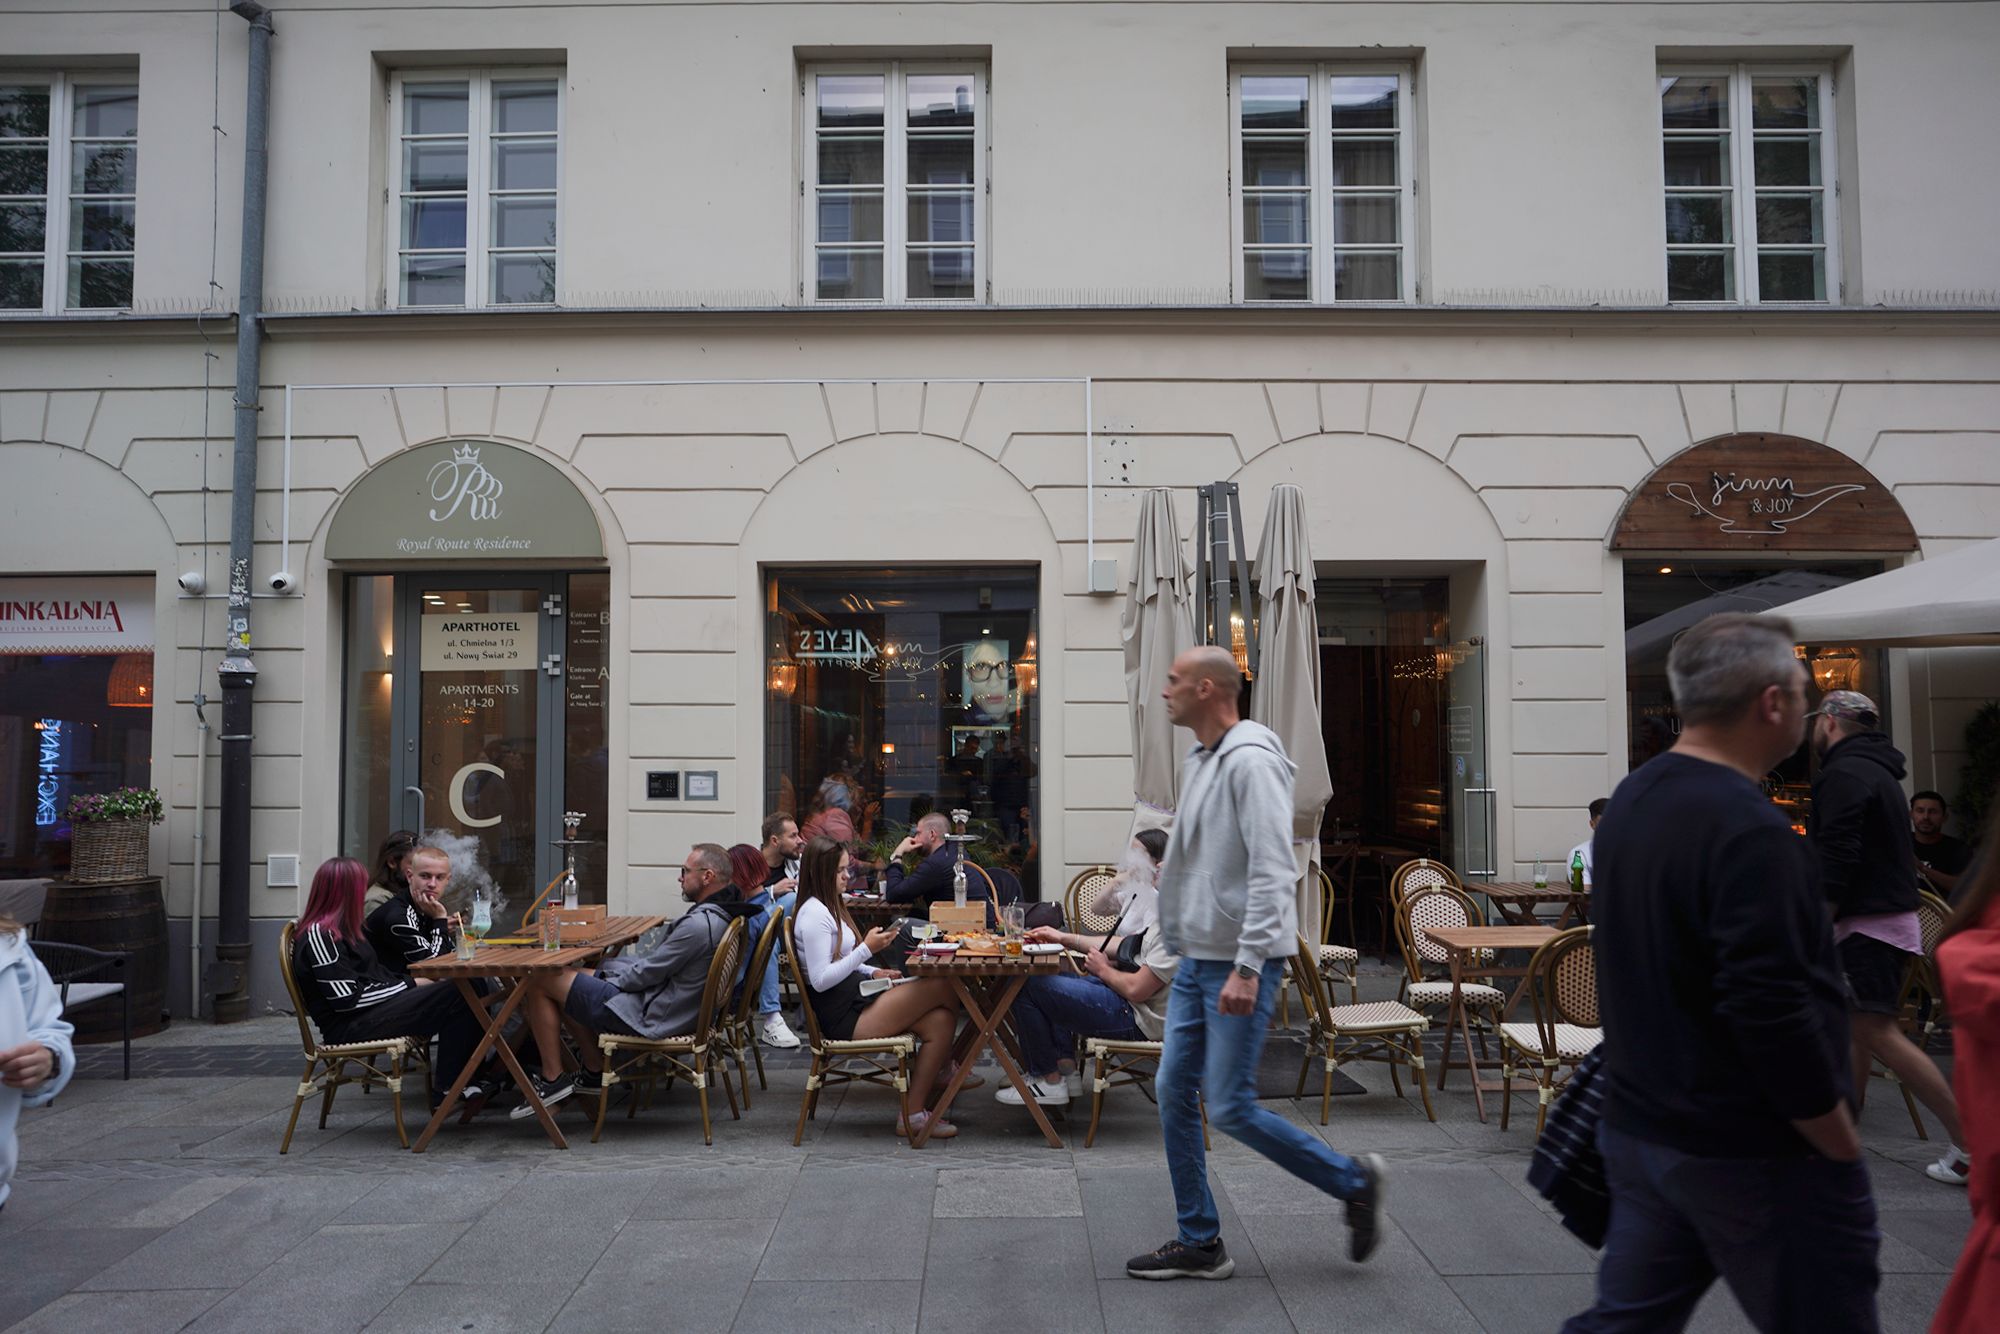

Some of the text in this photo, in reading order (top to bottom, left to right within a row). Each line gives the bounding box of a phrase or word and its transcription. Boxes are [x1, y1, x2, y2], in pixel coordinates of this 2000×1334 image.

[1752, 498, 1794, 513] & JOY
[397, 536, 532, 554] Royal Route Residence
[600, 611, 610, 625] B
[441, 622, 520, 632] APARTHOTEL
[460, 638, 497, 647] Chmielna
[501, 638, 514, 647] 1/3
[443, 650, 518, 661] ul. Nowy Świat 29
[598, 666, 610, 680] A
[440, 684, 519, 695] APARTMENTS
[464, 698, 494, 708] 14-20
[449, 762, 505, 828] C
